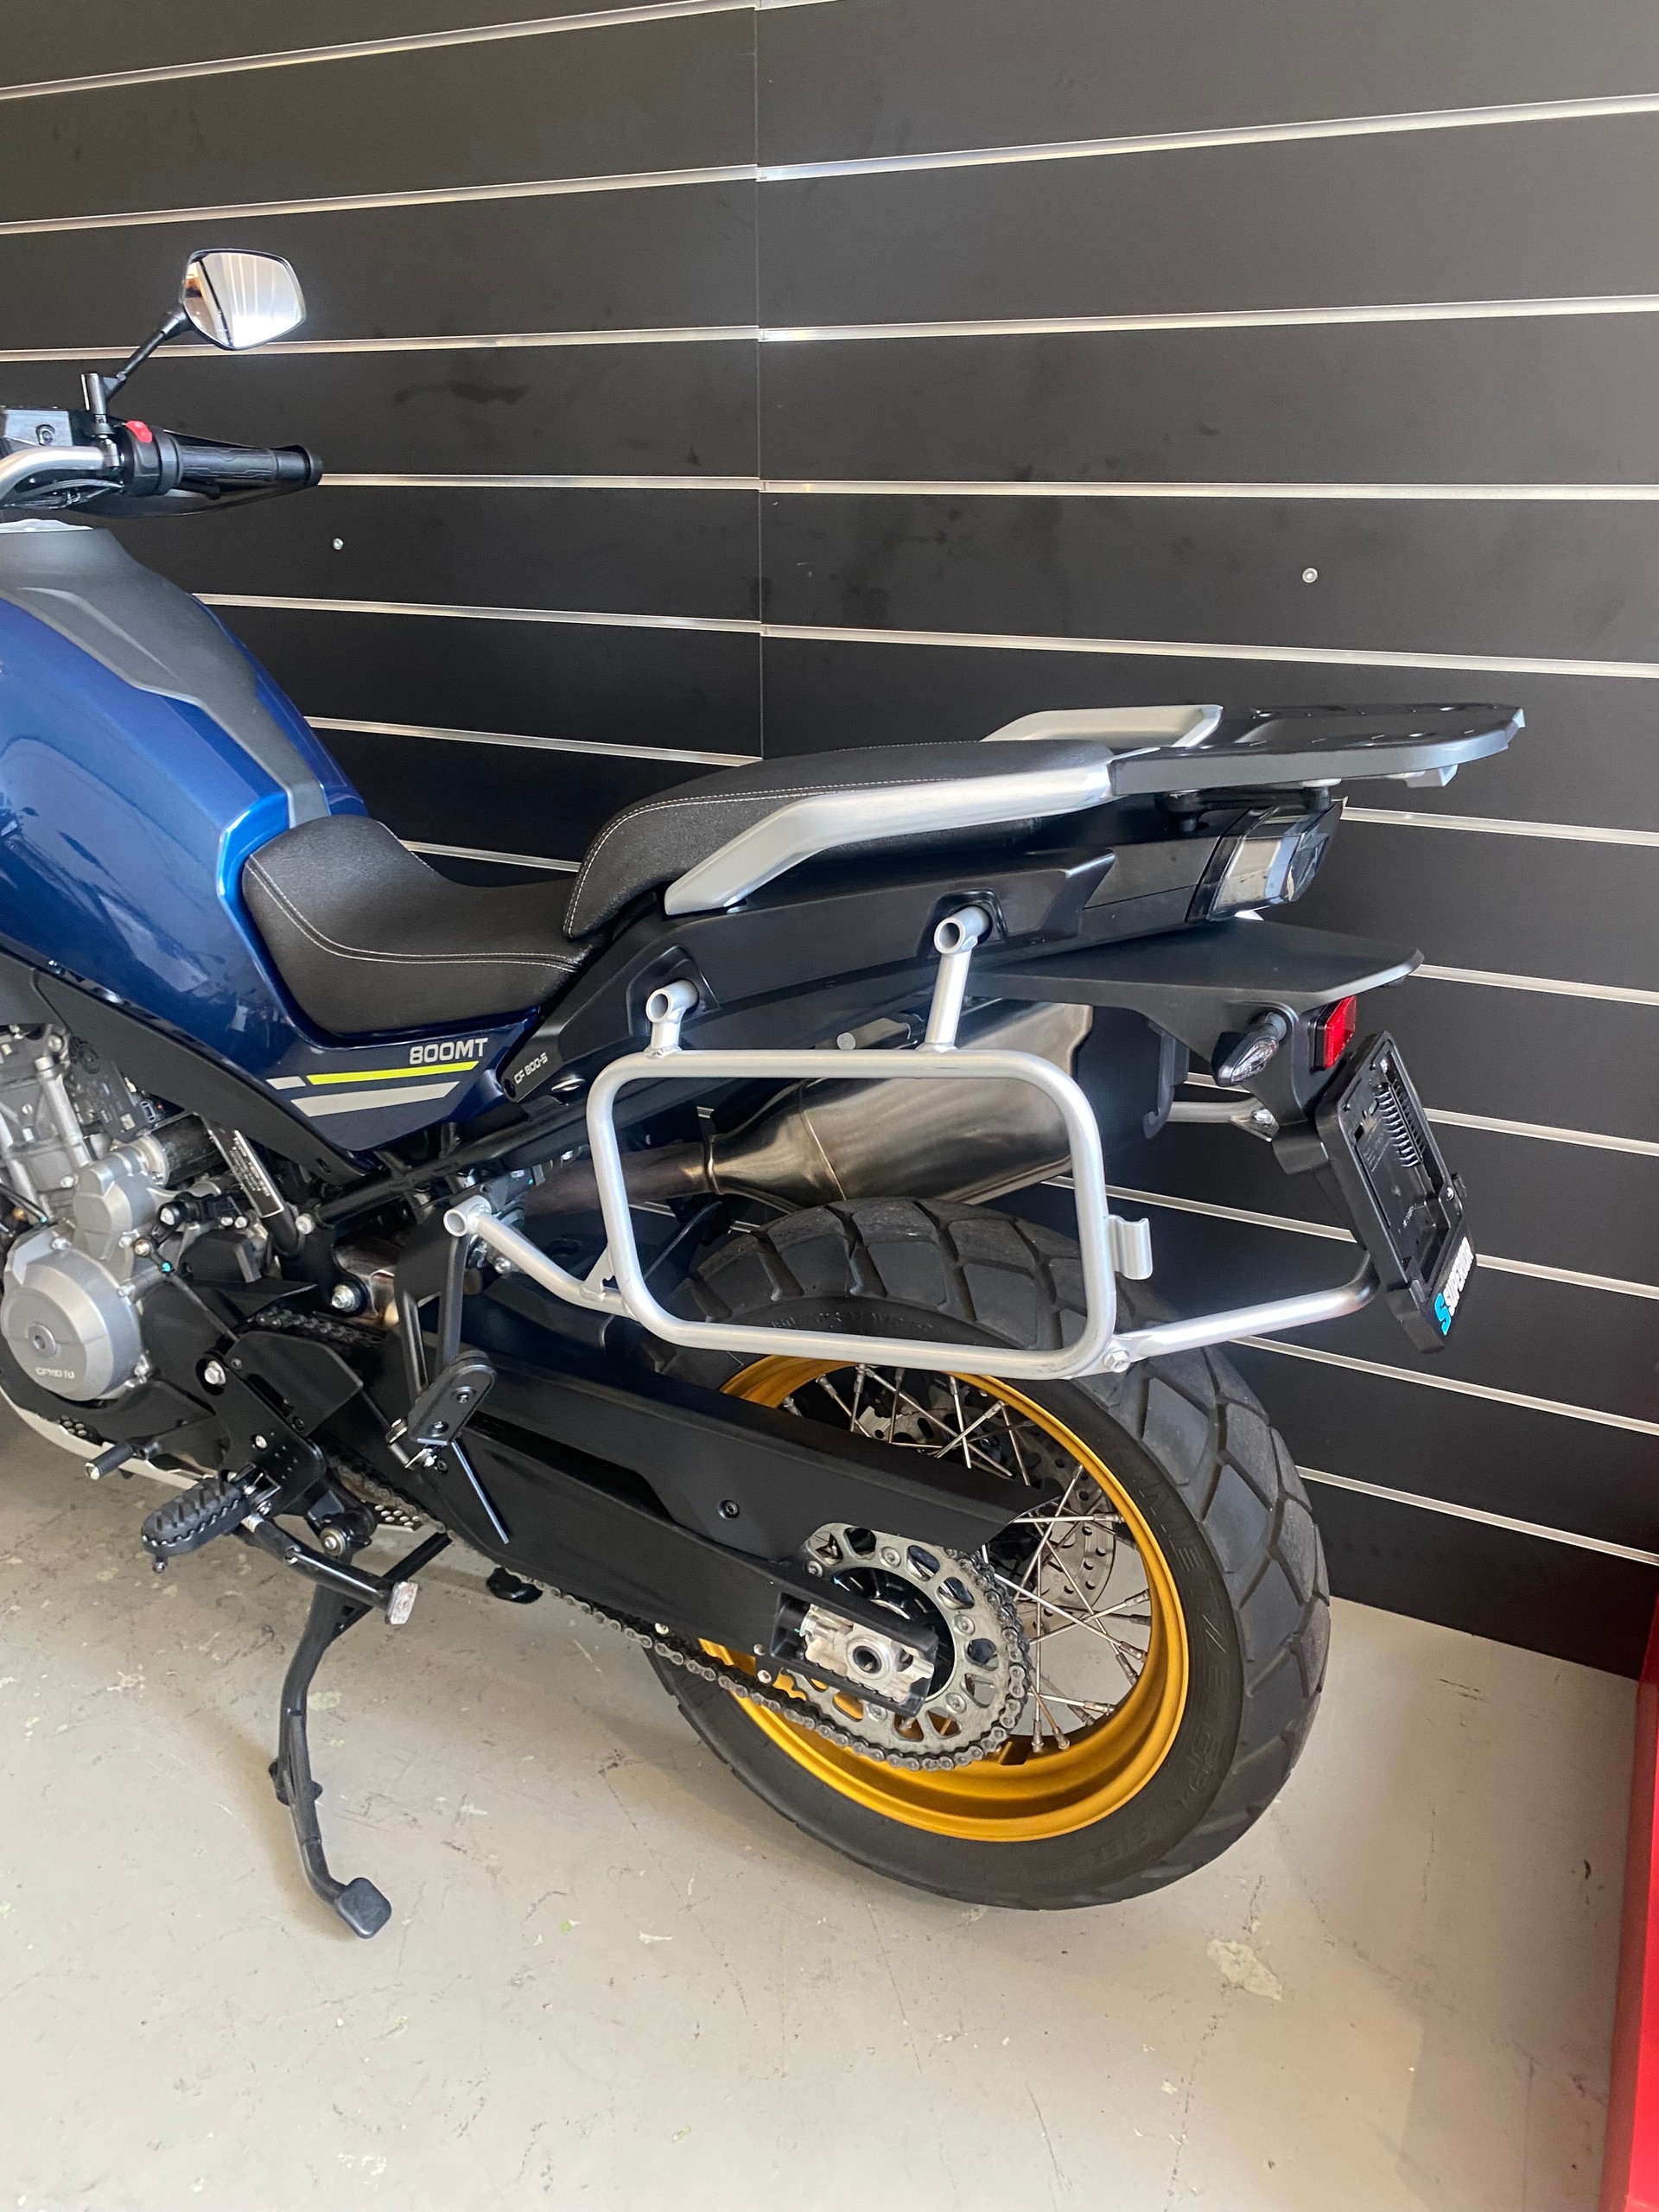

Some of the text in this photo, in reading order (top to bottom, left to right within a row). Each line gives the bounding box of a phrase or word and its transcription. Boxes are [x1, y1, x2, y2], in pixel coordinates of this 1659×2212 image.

[409, 1037, 488, 1065] 800MT
[513, 1052, 548, 1084] CF 800-S
[1442, 1236, 1474, 1317] SUPERIOR
